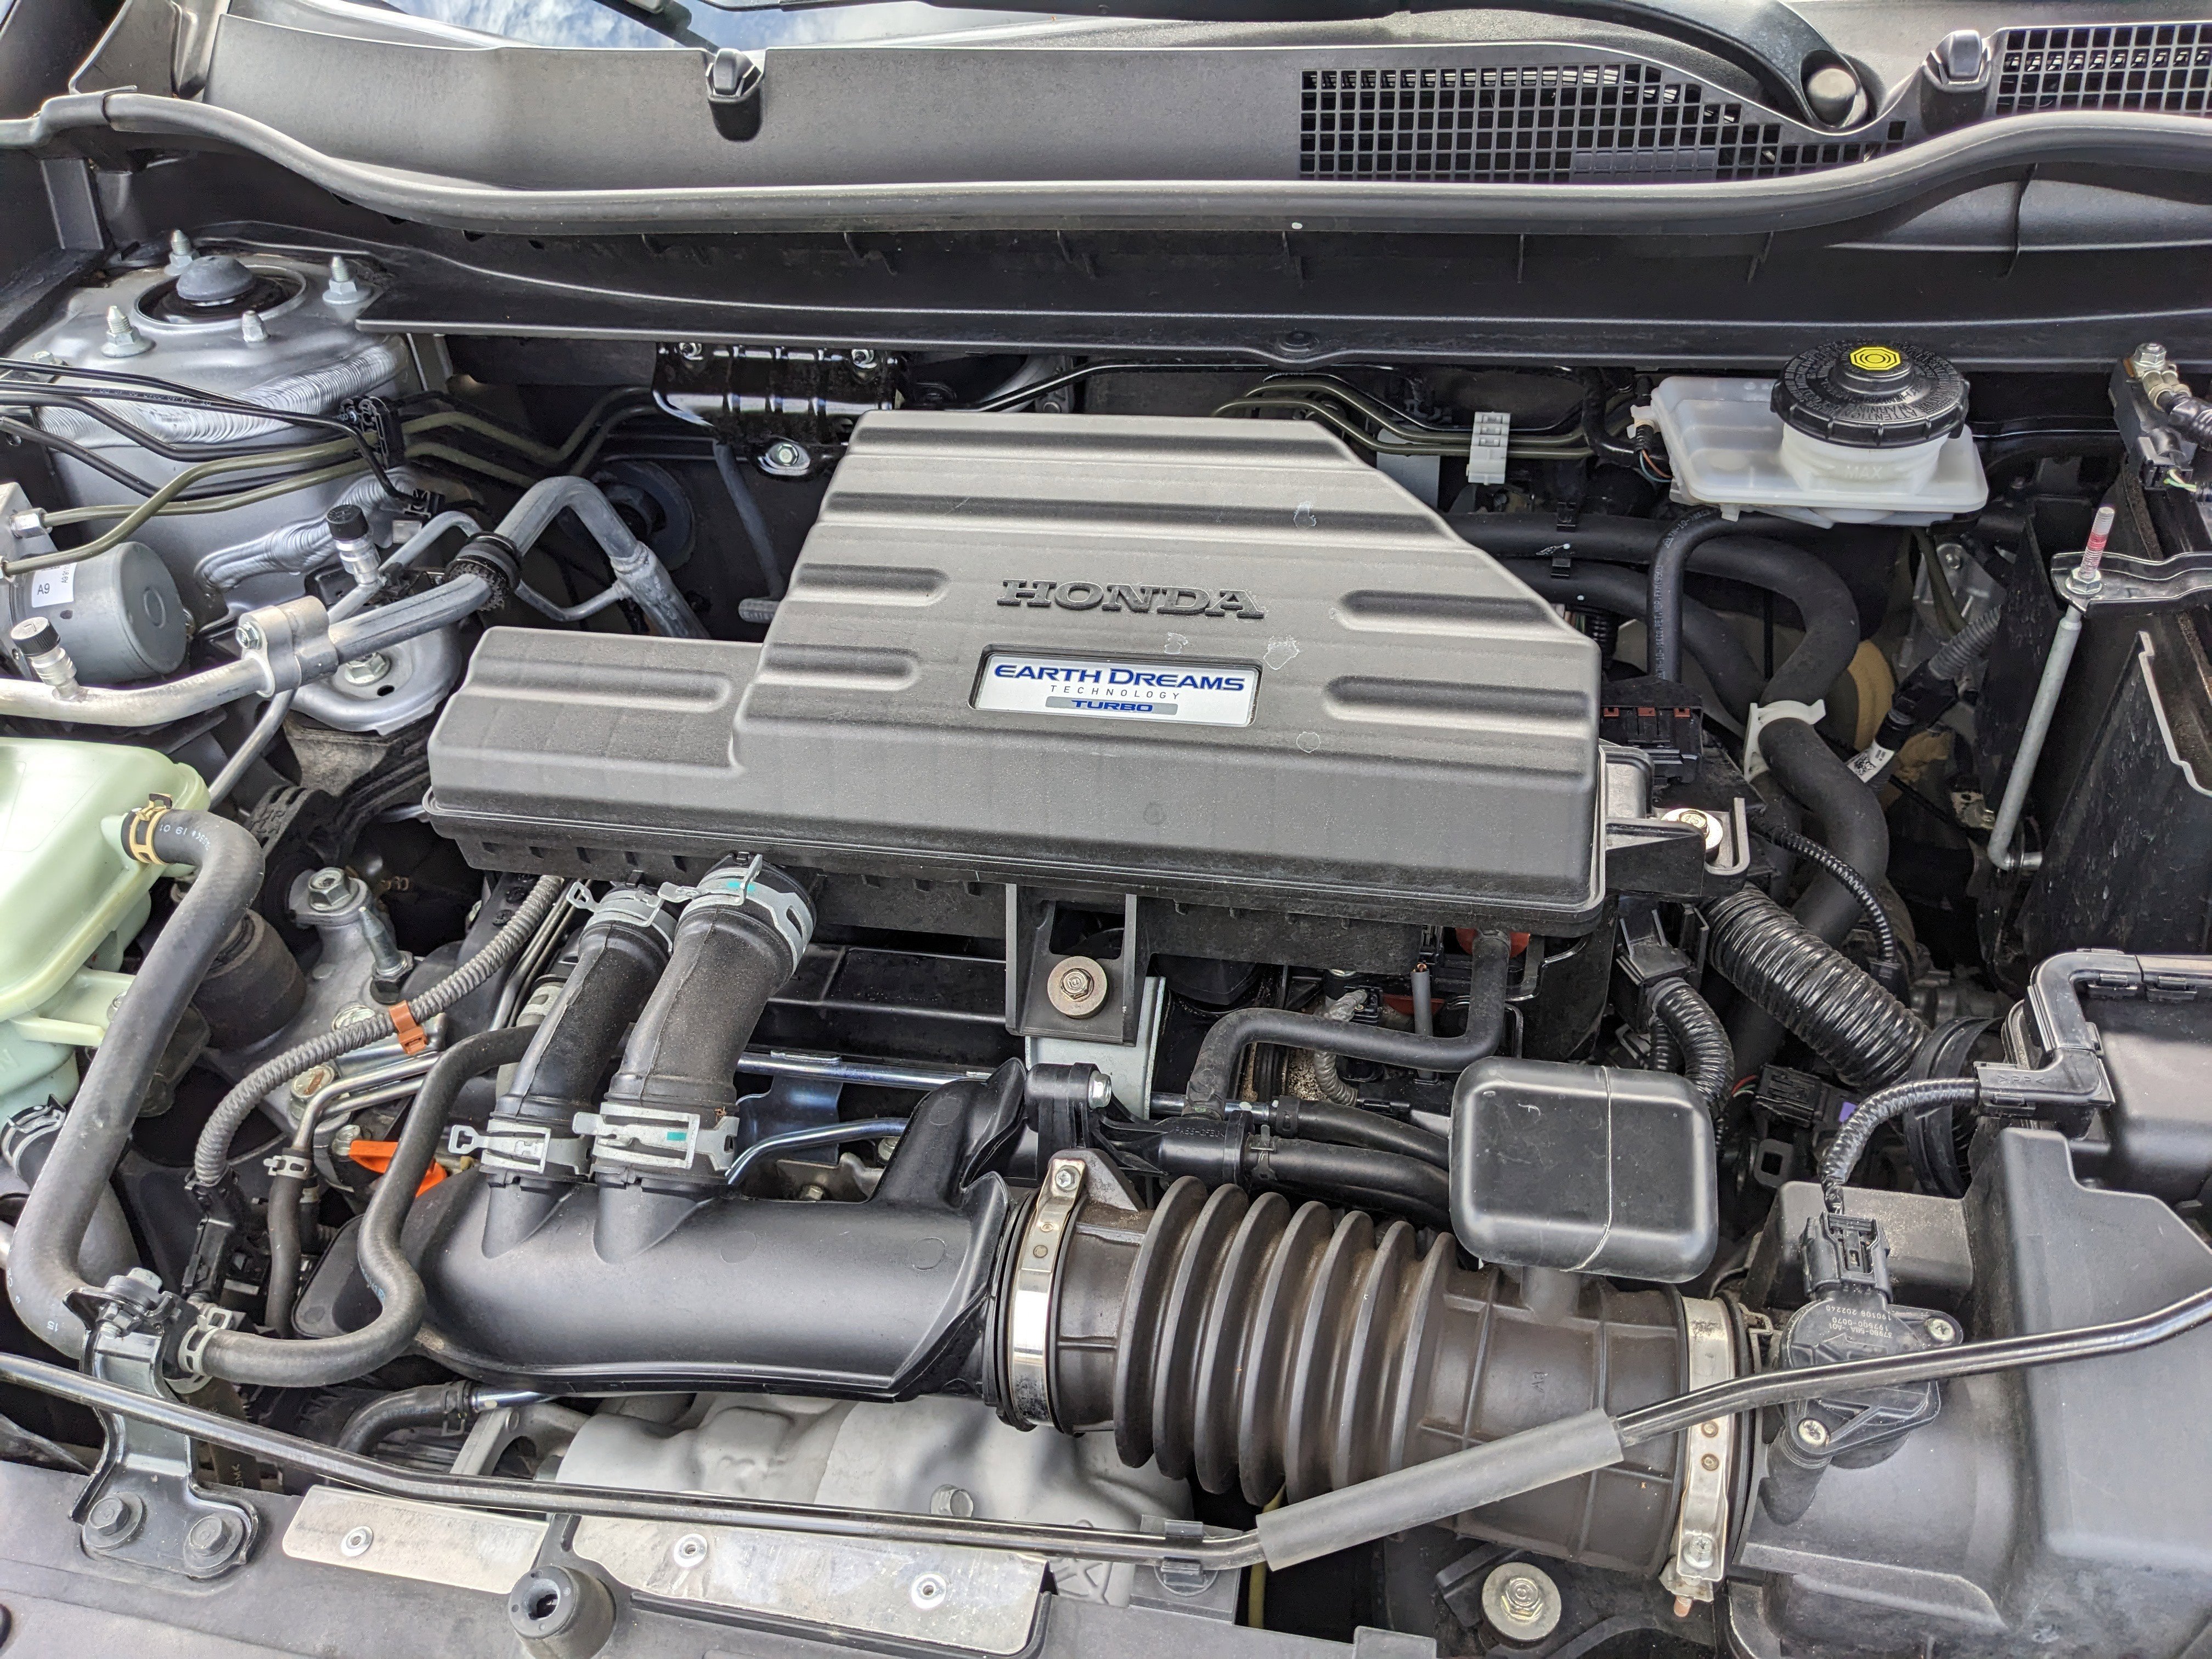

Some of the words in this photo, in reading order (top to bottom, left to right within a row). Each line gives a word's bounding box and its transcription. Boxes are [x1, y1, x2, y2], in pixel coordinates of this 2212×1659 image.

[1844, 465, 1882, 479] MAX
[37, 583, 50, 595] A9
[996, 578, 1264, 619] HONDA
[995, 664, 1102, 684] EARTH
[1107, 667, 1246, 692] DREAMS
[1050, 685, 1180, 701] TECHNOLOGY
[1071, 700, 1154, 713] TURBO
[1826, 1305, 1858, 1316] 202240
[47, 1321, 58, 1332] 15
